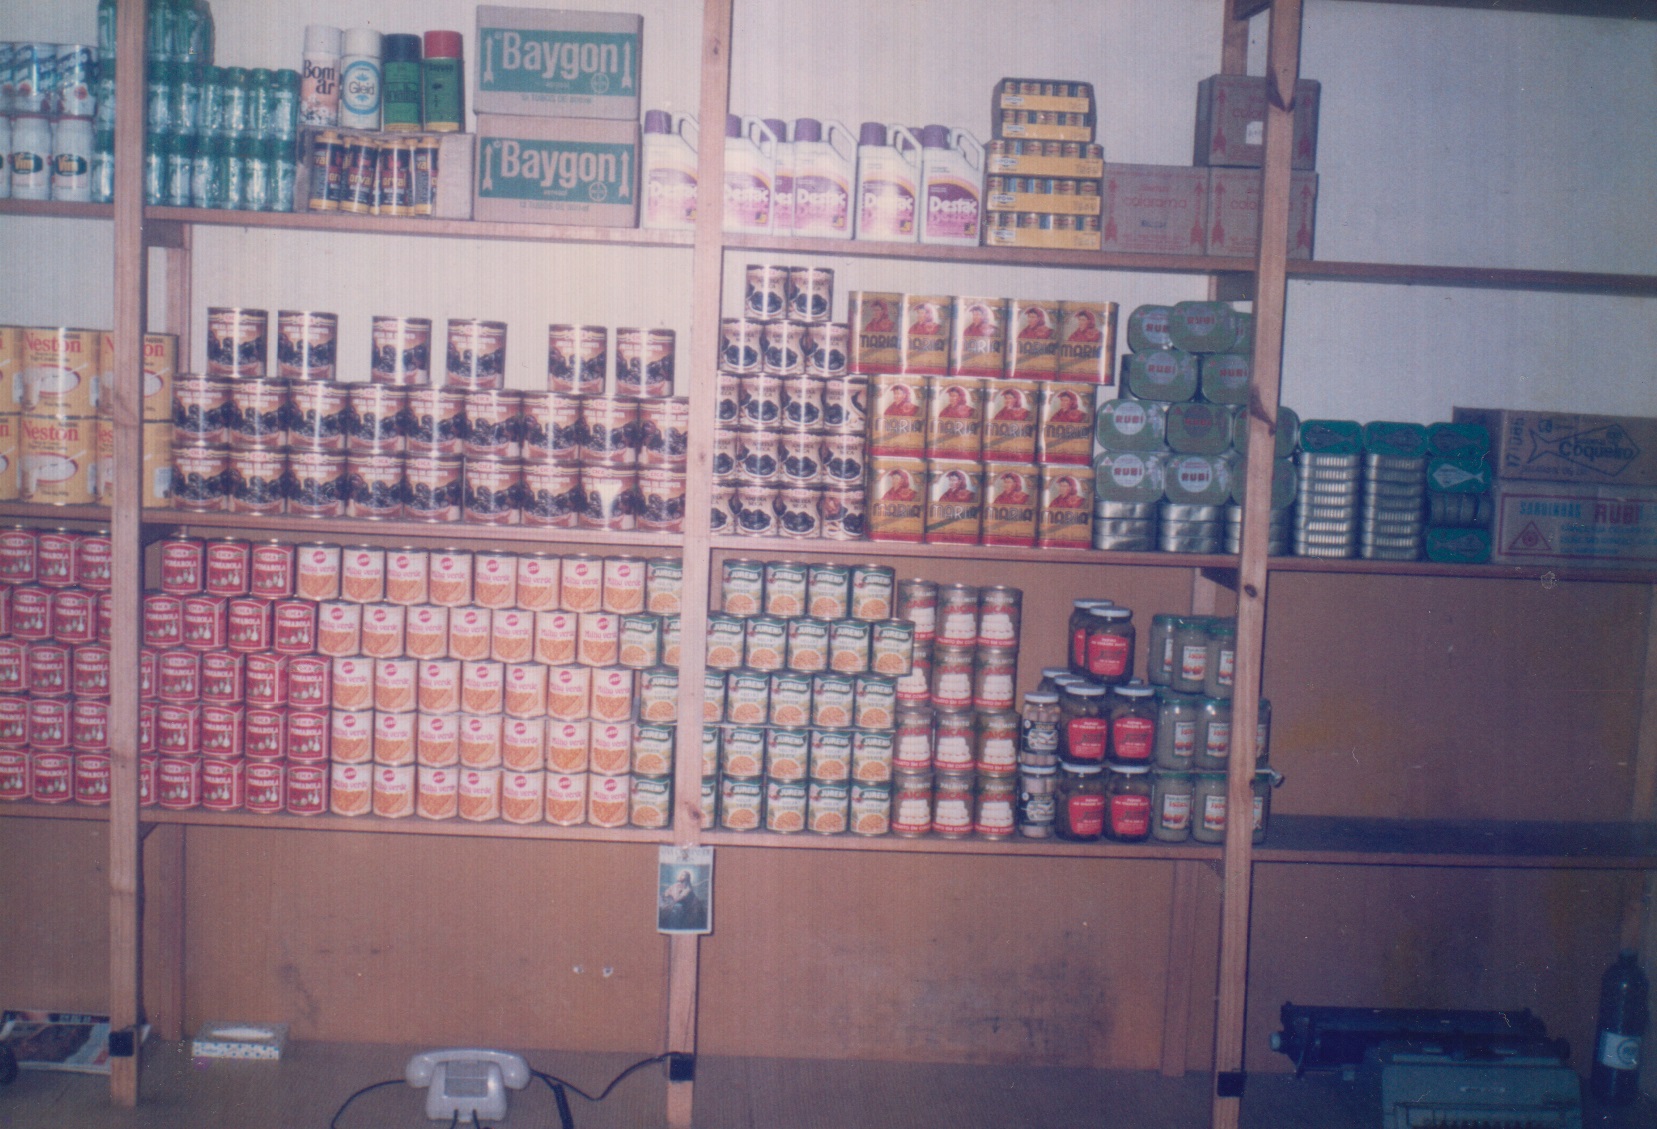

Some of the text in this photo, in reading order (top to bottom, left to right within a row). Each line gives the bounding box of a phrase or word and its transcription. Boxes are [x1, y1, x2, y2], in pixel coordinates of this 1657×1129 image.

[503, 31, 618, 80] Baygon
[304, 60, 335, 79] Bom
[316, 79, 335, 95] ar
[350, 81, 375, 95] Gleid
[501, 141, 616, 189] Baygon
[25, 332, 81, 353] Neston
[23, 420, 79, 441] Neston
